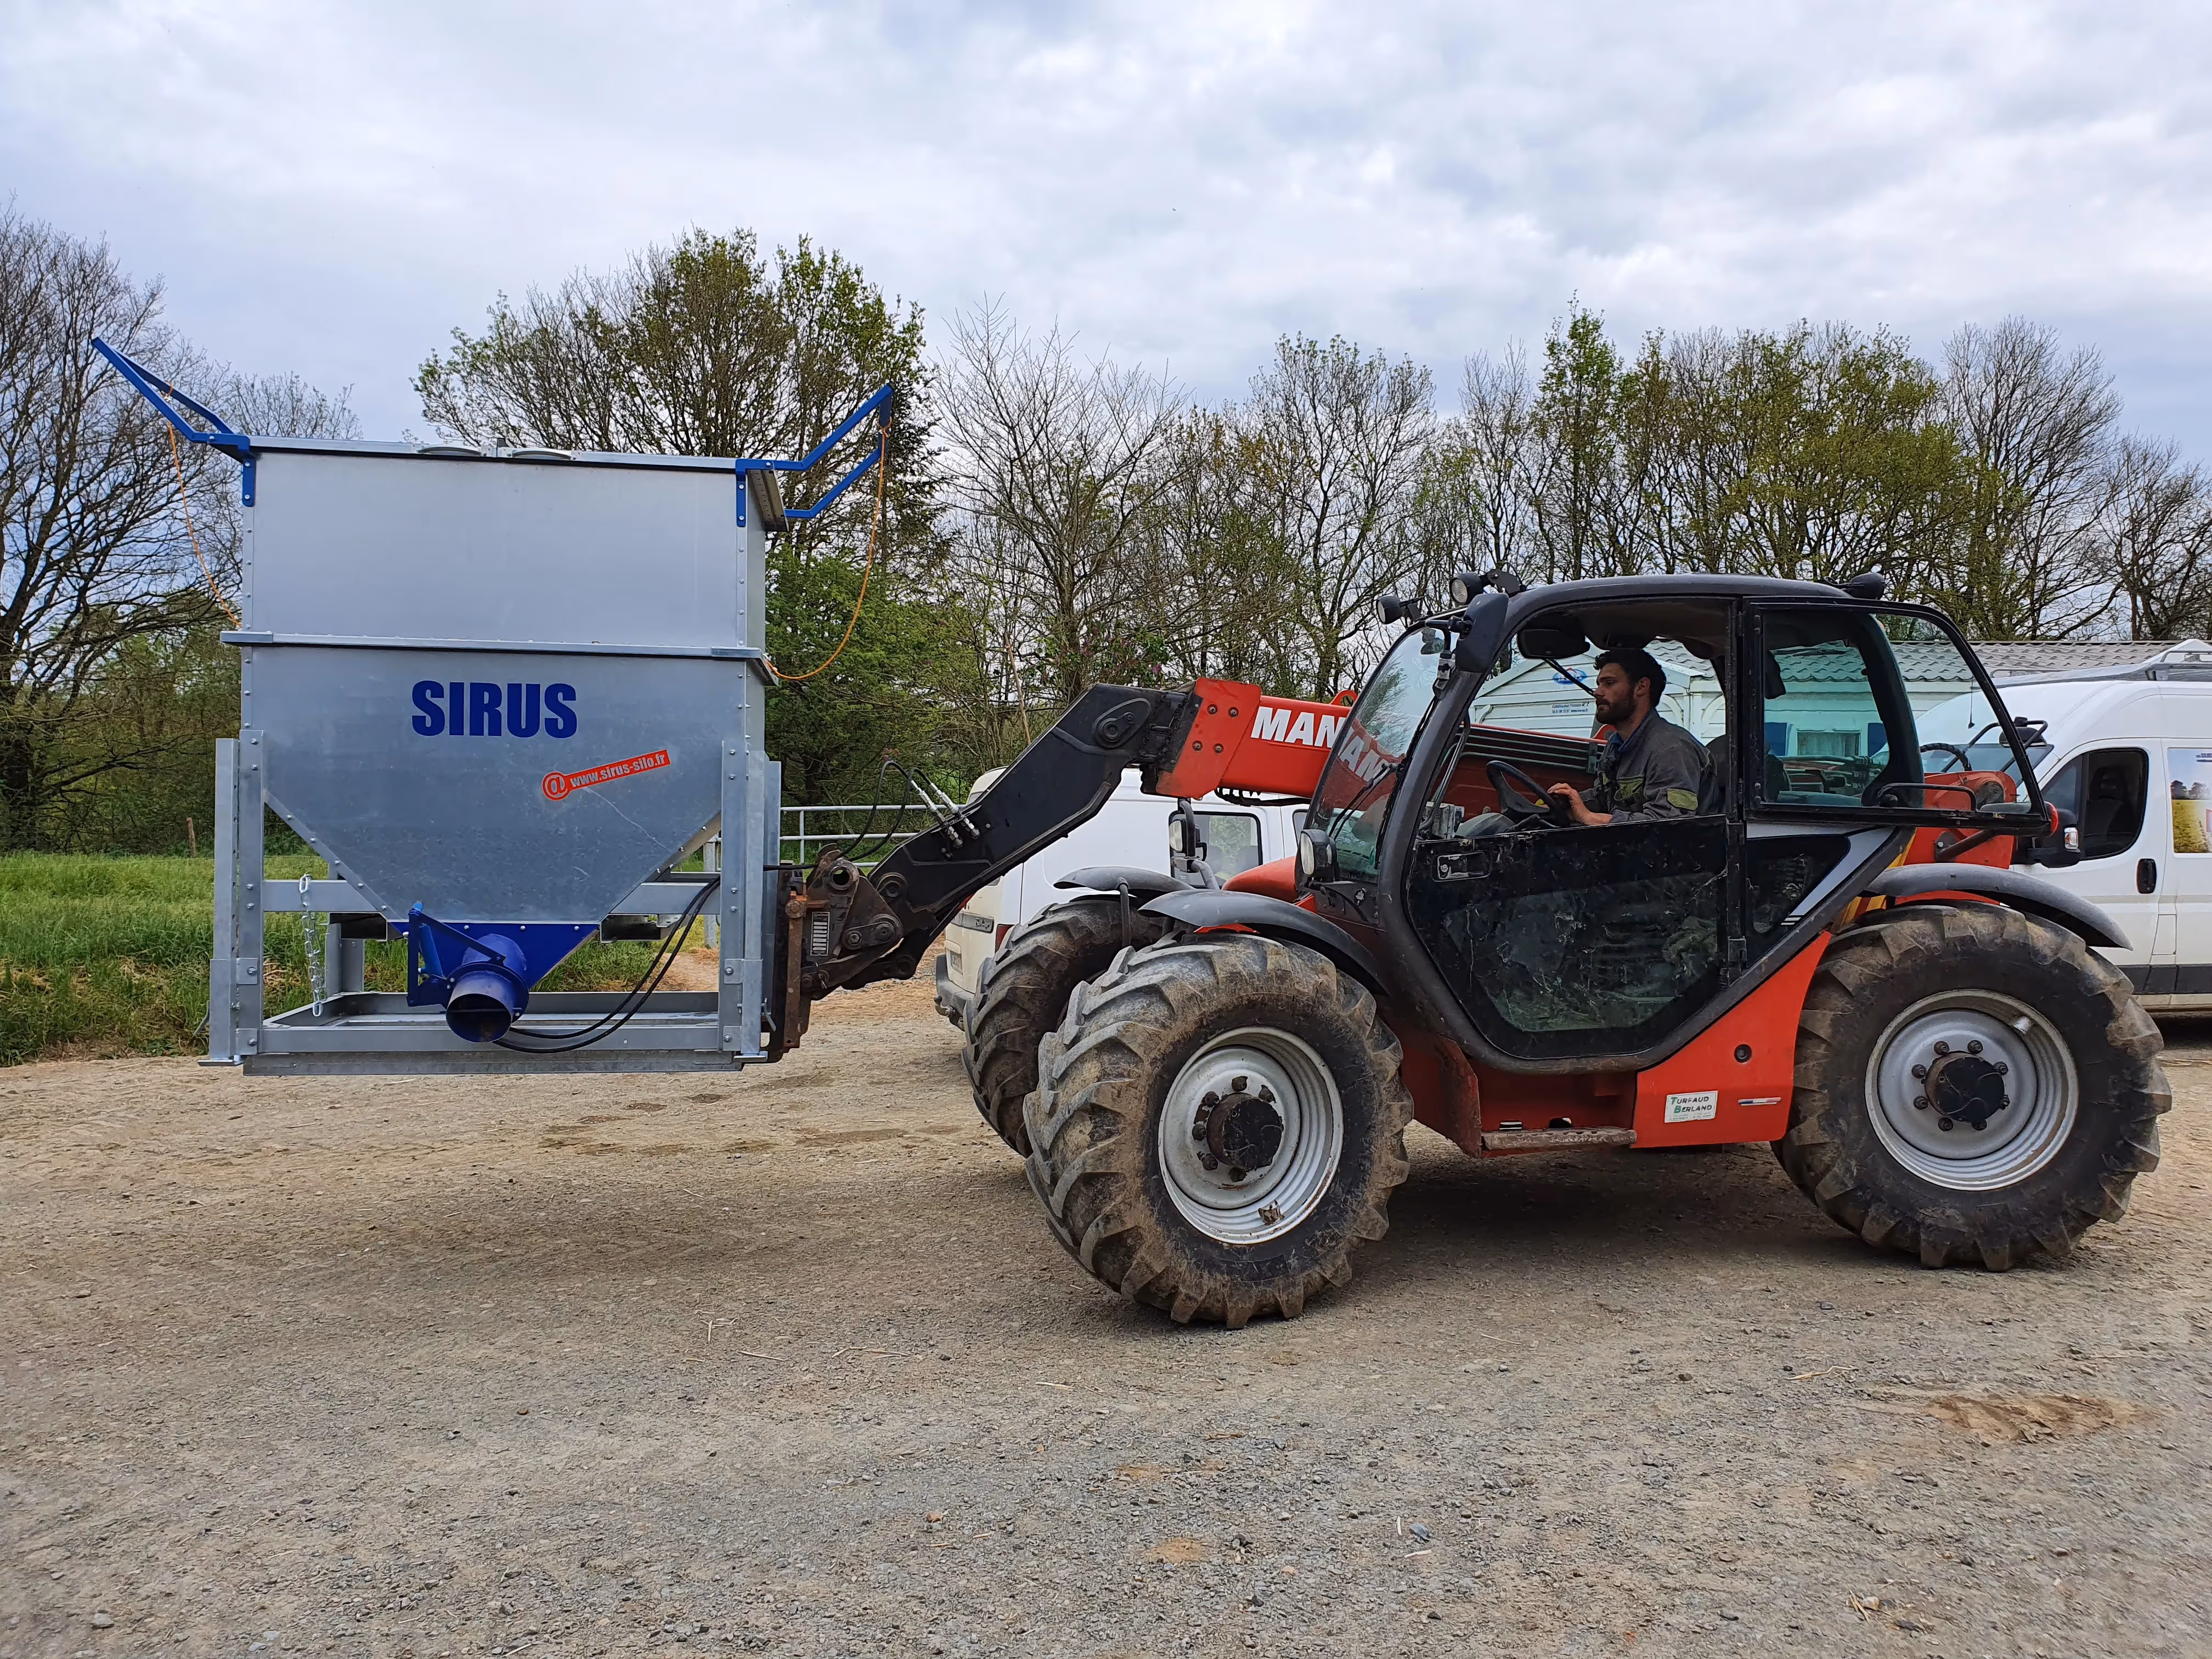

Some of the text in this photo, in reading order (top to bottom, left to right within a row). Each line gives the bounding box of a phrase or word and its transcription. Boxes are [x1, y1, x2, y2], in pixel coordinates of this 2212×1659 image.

[411, 680, 577, 738] SIRUS
[569, 753, 665, 788] www.sirus-silo.fr
[1674, 1104, 1712, 1114] BERLAND
